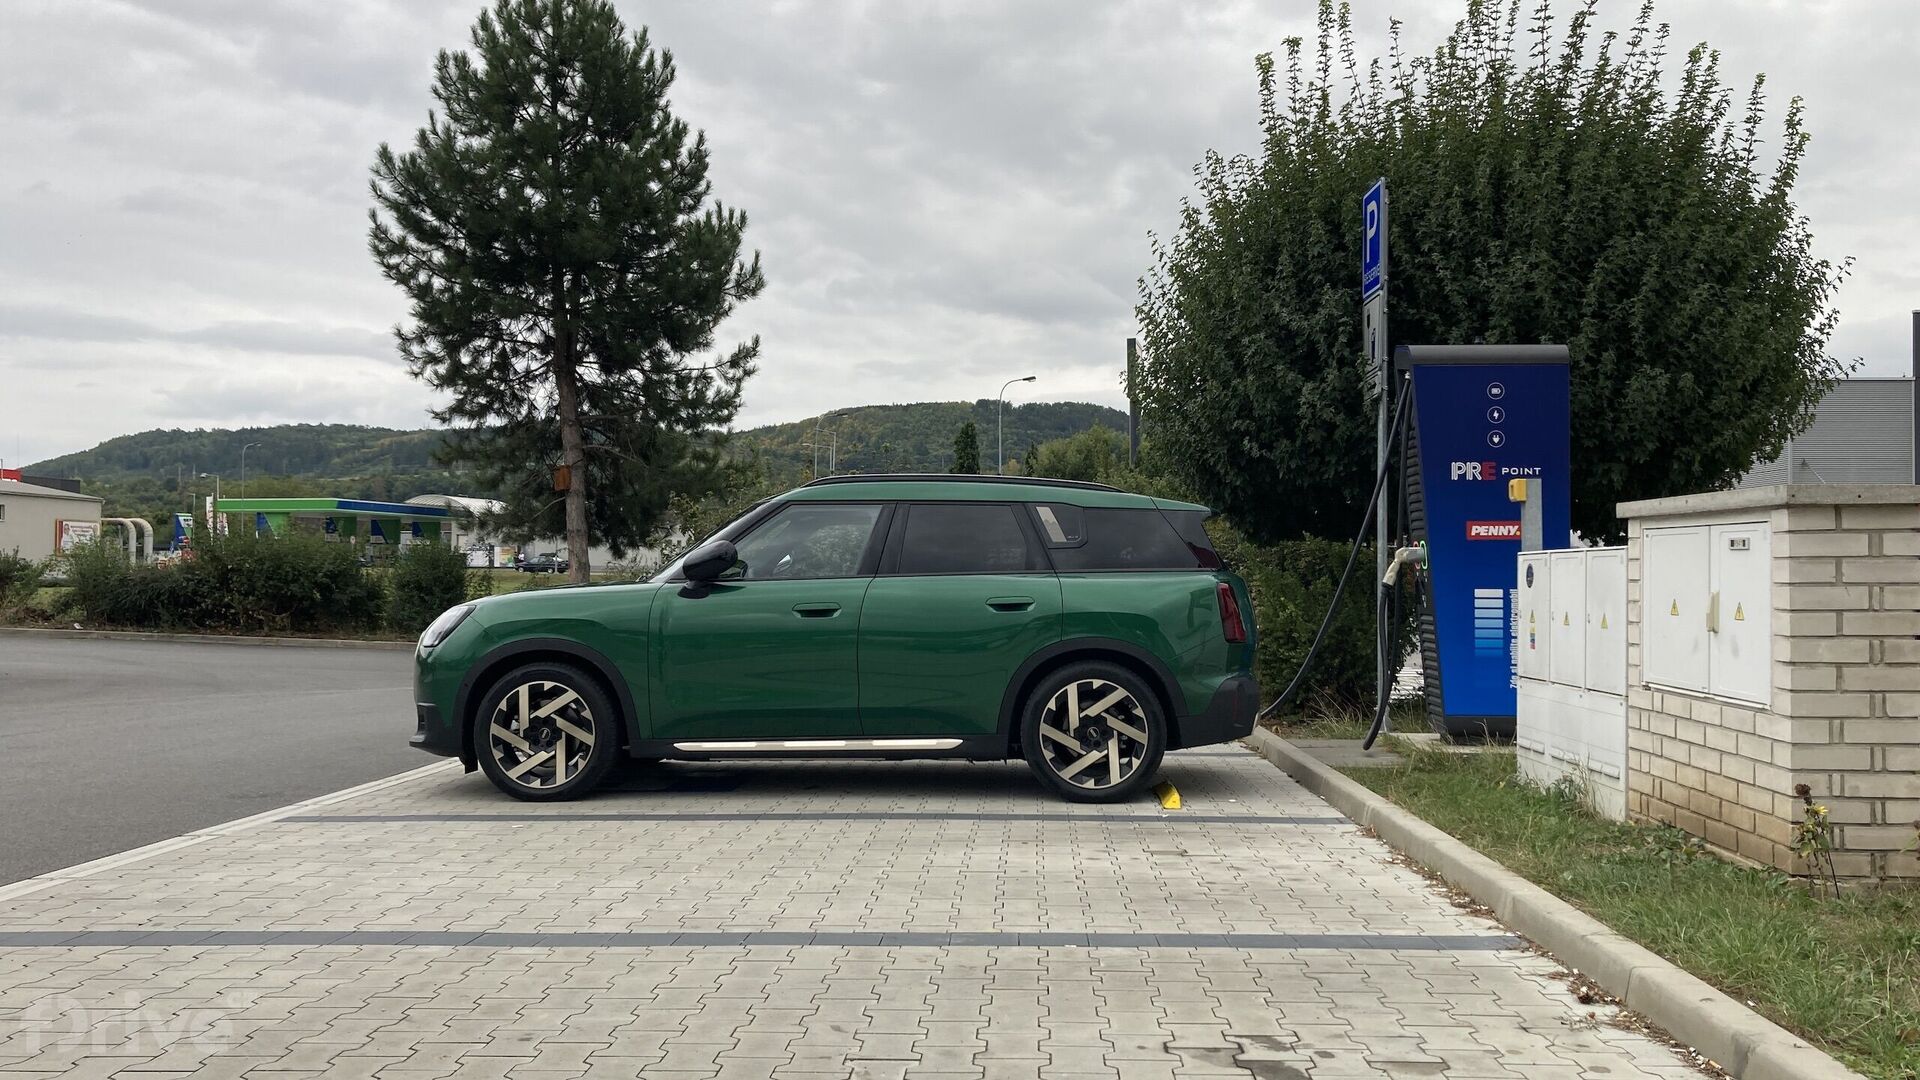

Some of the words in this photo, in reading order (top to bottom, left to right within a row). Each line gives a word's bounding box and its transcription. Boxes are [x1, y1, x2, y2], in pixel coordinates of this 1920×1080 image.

[1367, 200, 1378, 263] P
[1451, 462, 1496, 480] PRE
[1502, 467, 1541, 475] POINT
